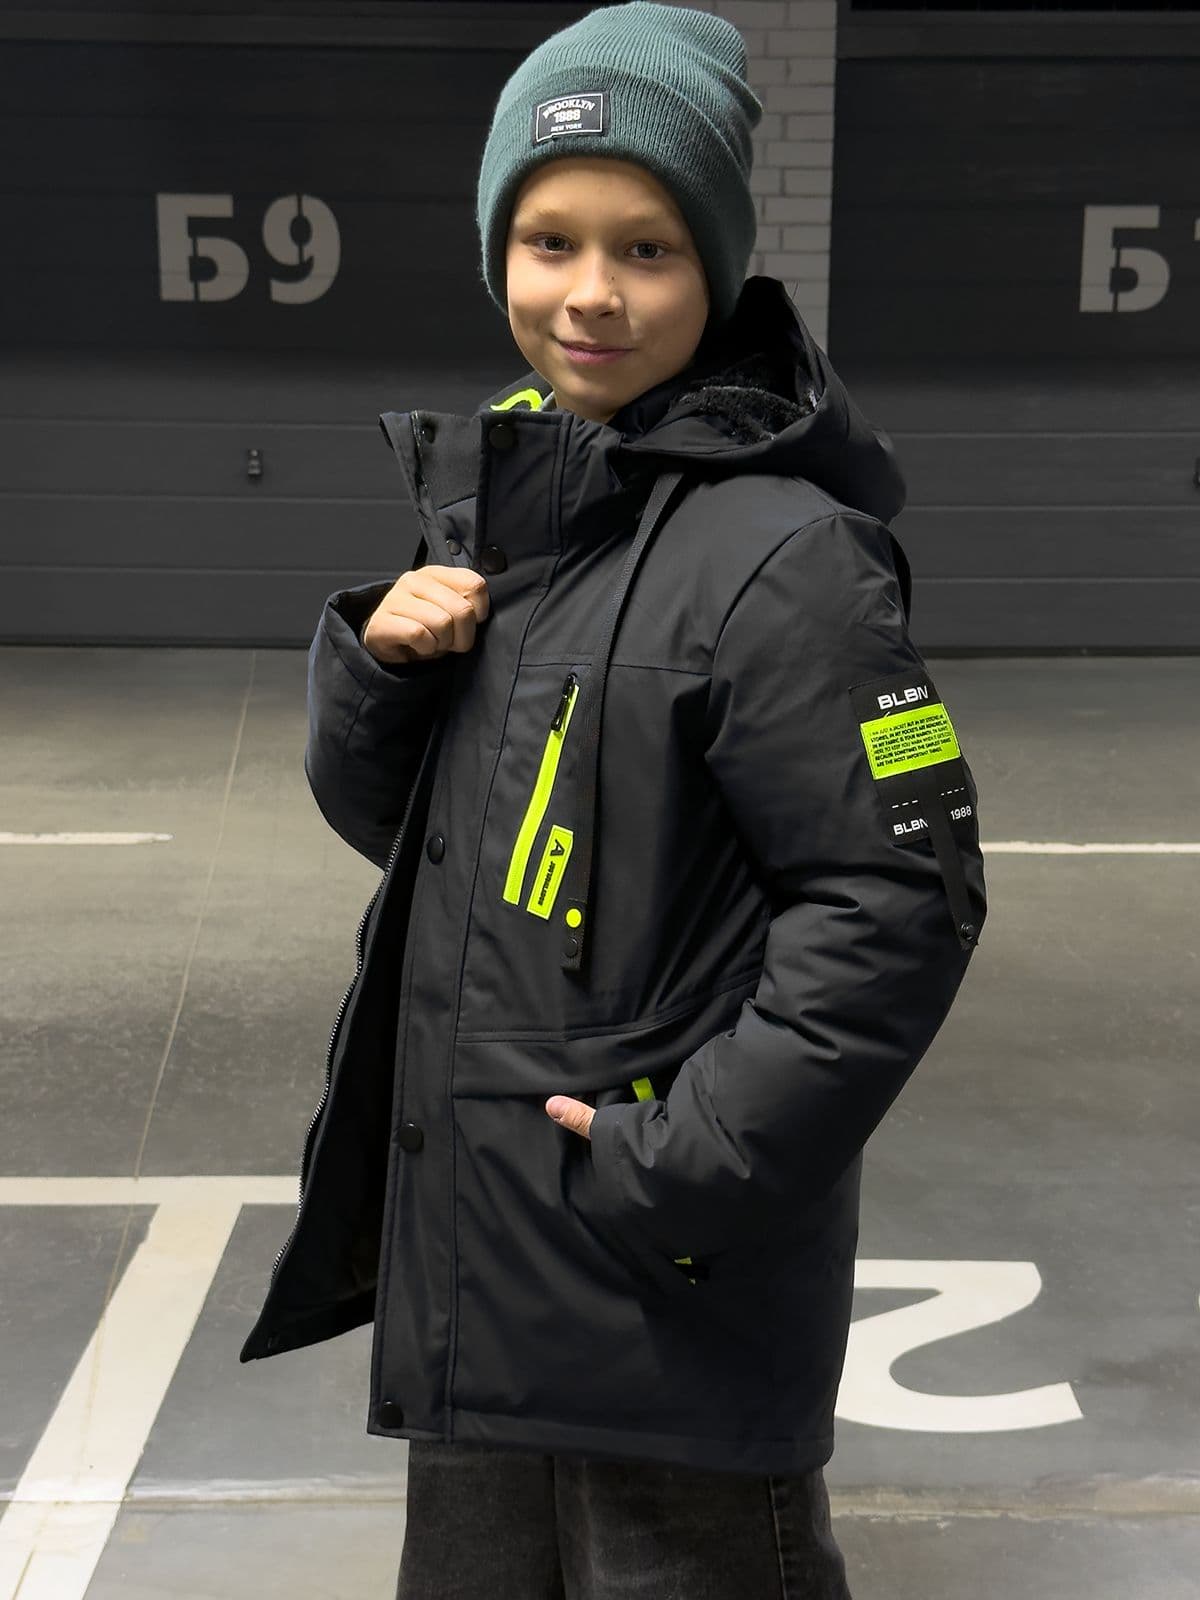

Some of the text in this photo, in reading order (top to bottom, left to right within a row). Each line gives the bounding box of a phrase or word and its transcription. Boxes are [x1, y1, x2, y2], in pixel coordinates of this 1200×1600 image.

[156, 193, 341, 304] Б9
[1079, 204, 1200, 313] Б
[877, 685, 929, 710] BLBN
[950, 805, 972, 821] 1988
